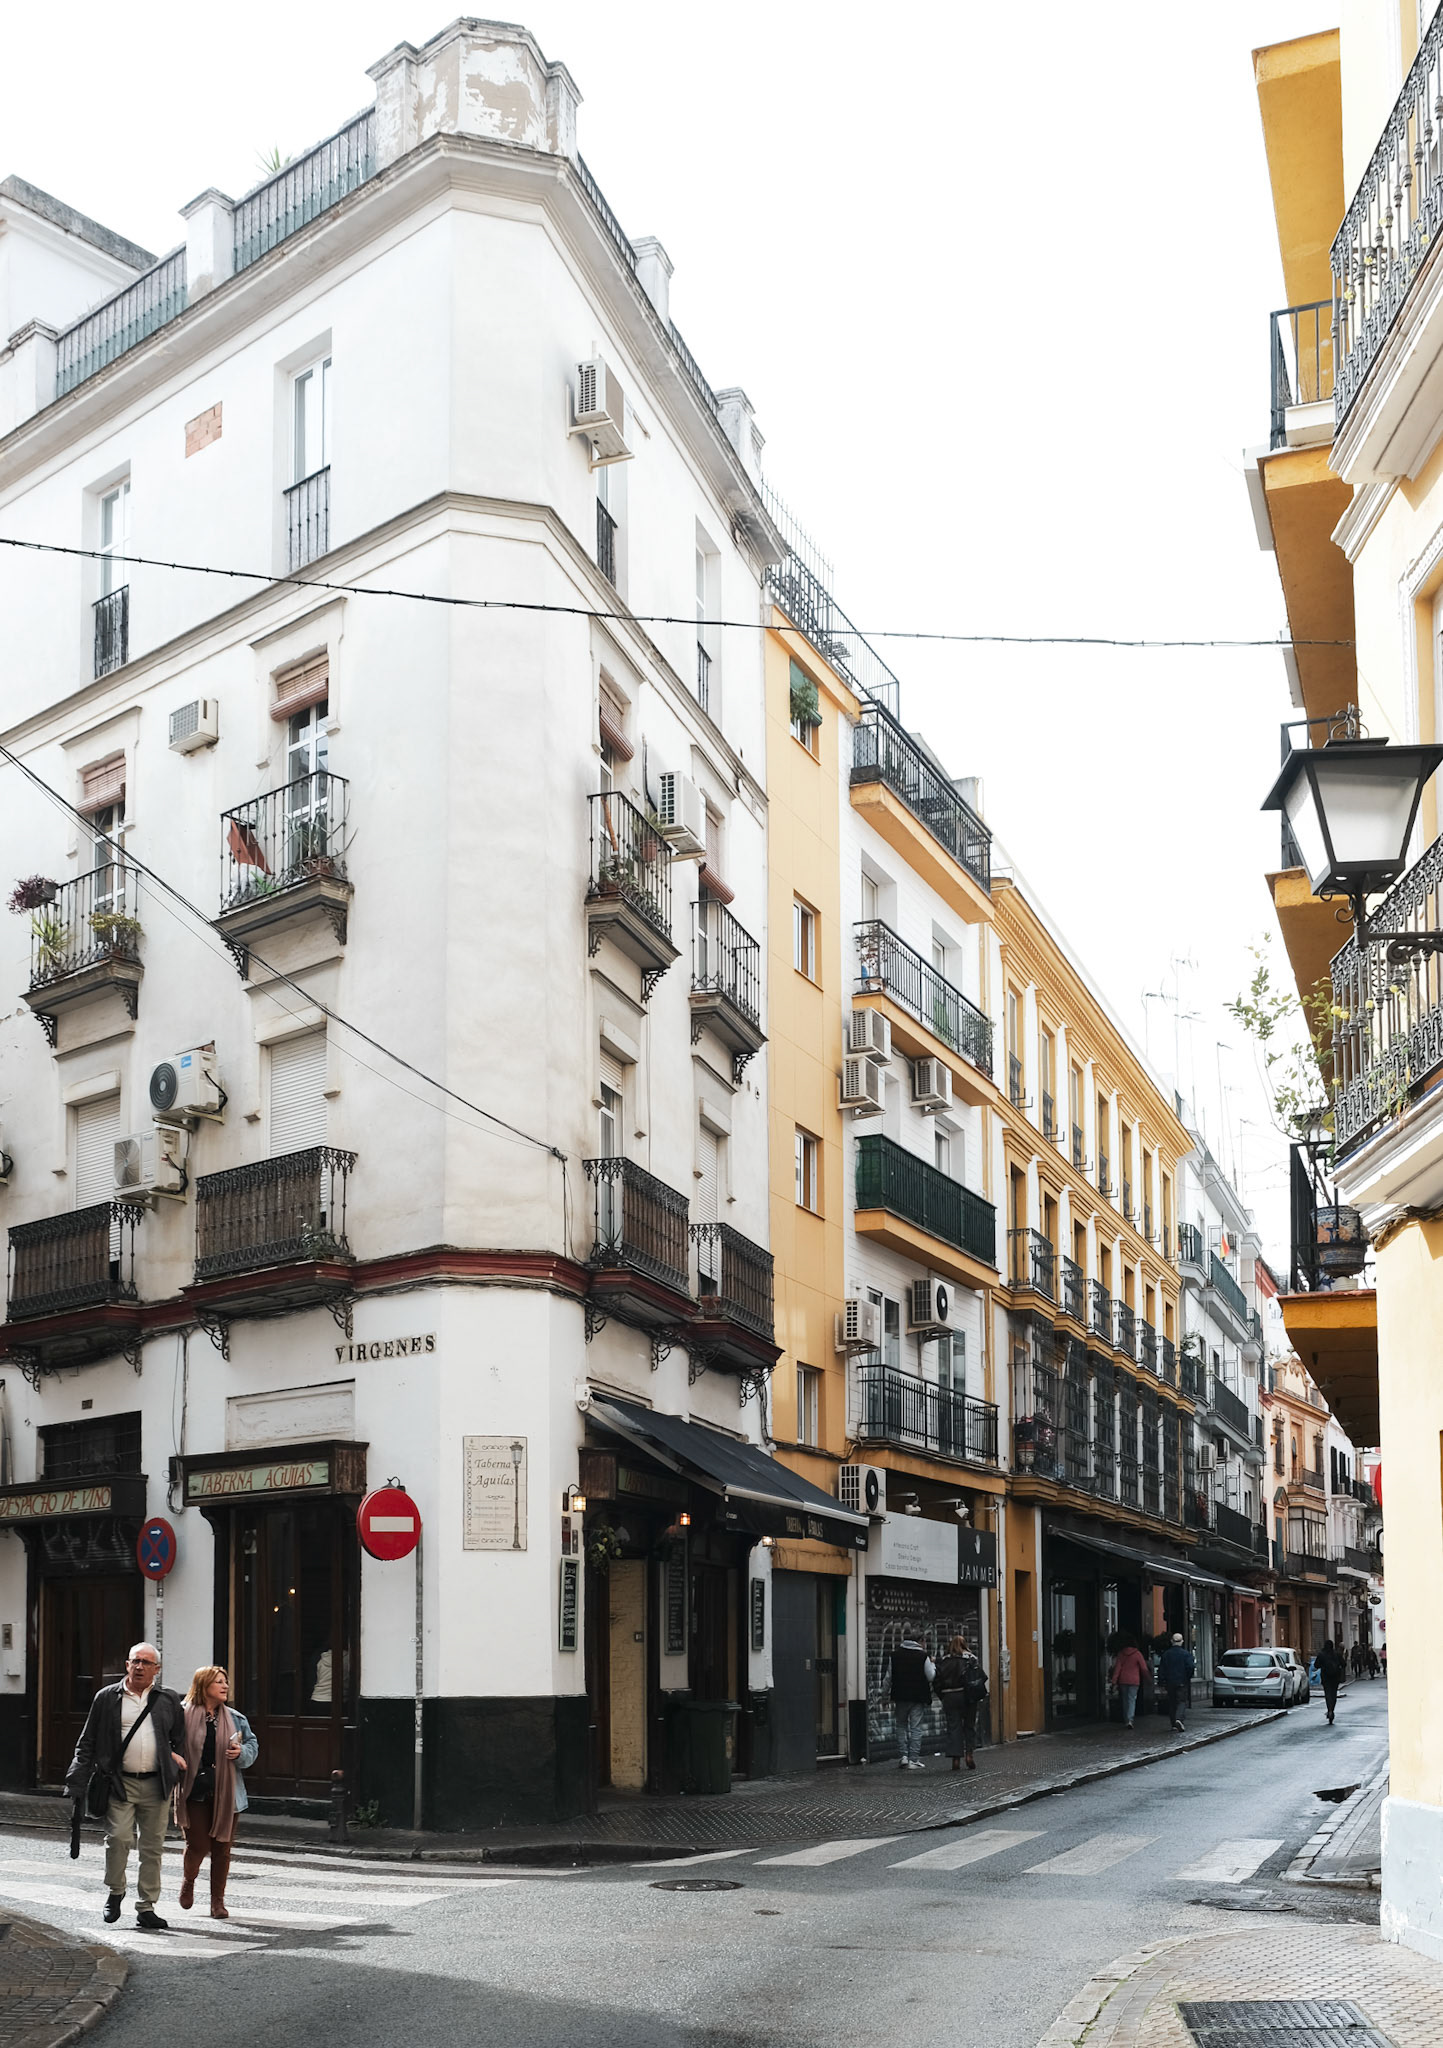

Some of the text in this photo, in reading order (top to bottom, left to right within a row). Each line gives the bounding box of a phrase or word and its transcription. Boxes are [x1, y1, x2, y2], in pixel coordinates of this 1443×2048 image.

[335, 1334, 435, 1364] VIRGENES
[474, 1458, 511, 1469] Taberna
[200, 1471, 253, 1494] TABERNA
[473, 1474, 515, 1488] Aguilas
[0, 1487, 111, 1516] DESPACHO DE VINO
